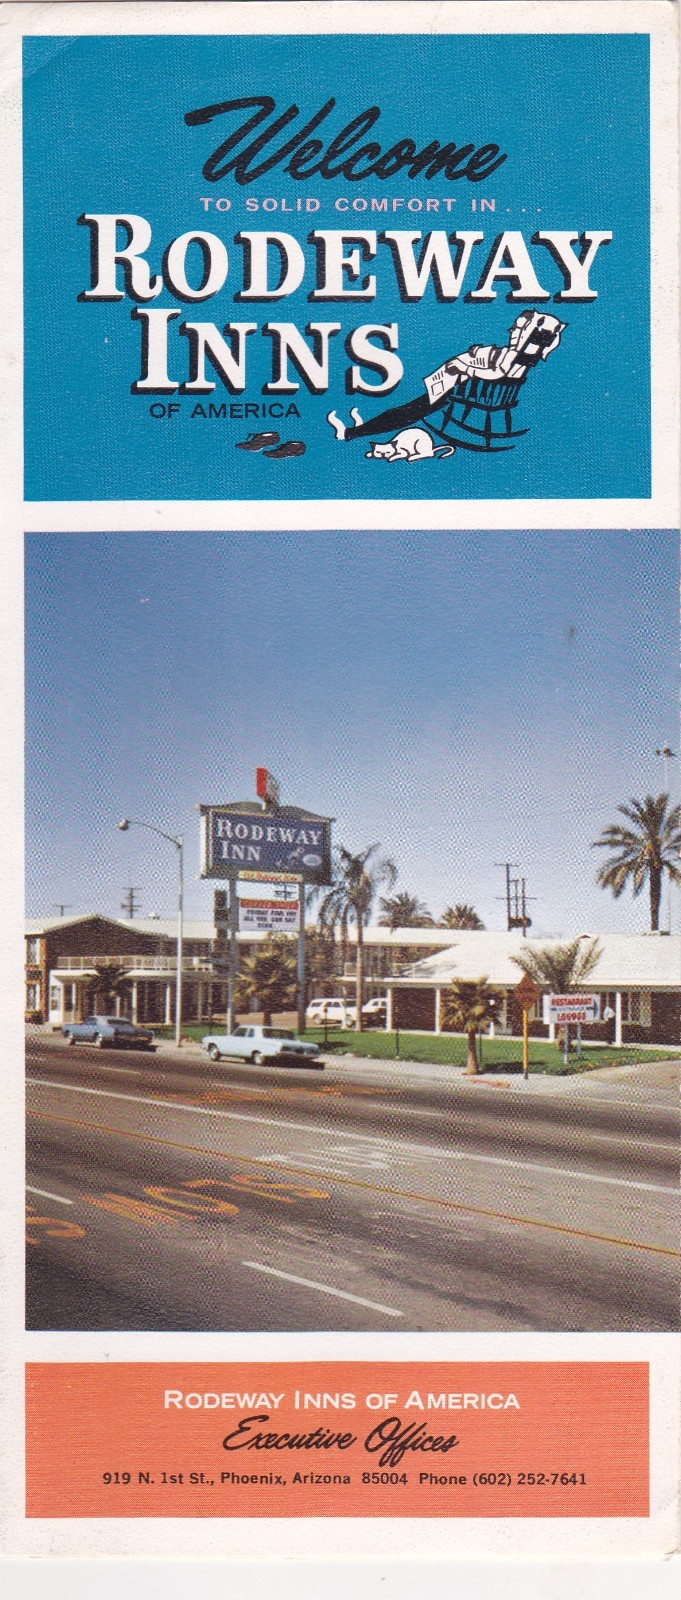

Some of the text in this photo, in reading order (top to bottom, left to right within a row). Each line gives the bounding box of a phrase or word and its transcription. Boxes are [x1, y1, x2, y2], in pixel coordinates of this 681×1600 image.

[184, 95, 507, 186] Welcome
[200, 197, 232, 212] TO
[245, 197, 321, 212] SOLID
[335, 197, 457, 212] COMFORT
[78, 213, 612, 302] RODEWAY
[132, 308, 405, 395] INNS
[149, 402, 302, 419] OF AMERICA
[216, 818, 322, 845] RODEWAY
[221, 841, 262, 861] INN
[164, 1389, 521, 1411] RODEWAY INNS OF AMERICA
[222, 1415, 460, 1468] Executive Offices
[102, 1472, 587, 1487] 919 N. 1st St., Phoenix, Arizona 85004 Phone (602) 252-7641
